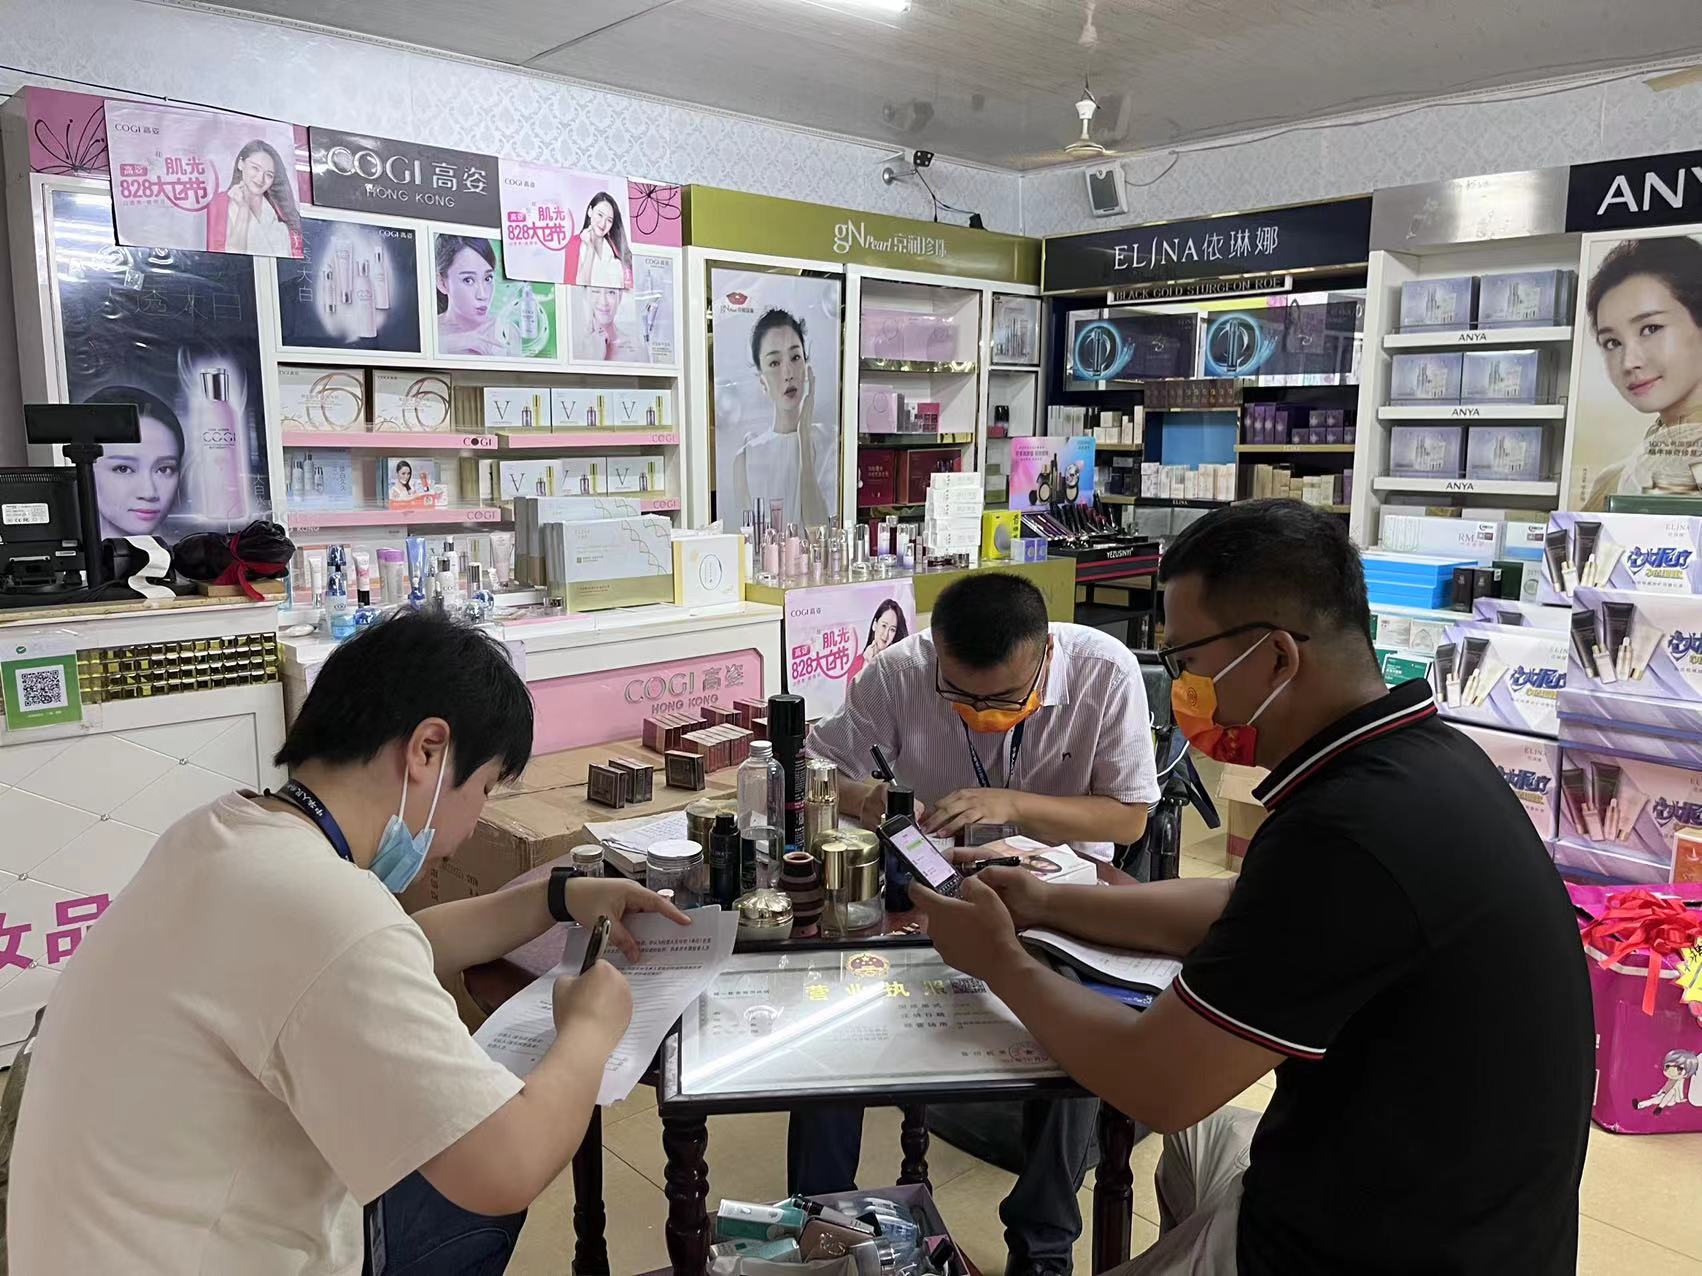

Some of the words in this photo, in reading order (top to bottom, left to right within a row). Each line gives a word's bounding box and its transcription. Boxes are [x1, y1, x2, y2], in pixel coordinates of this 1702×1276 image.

[115, 123, 141, 133] COGI
[165, 156, 206, 176] 肌光
[327, 146, 422, 185] COGI
[431, 162, 488, 195] 高姿
[504, 178, 522, 186] COGI
[365, 185, 409, 201] HONG
[415, 193, 455, 208] KONG
[538, 206, 566, 222] 肌光
[379, 230, 399, 238] COGI
[1202, 226, 1279, 261] 依琳娜
[1116, 288, 1150, 301] BLACK
[1153, 285, 1183, 298] GOLD
[1458, 332, 1487, 342] ANYA
[1452, 408, 1480, 417] ANYA
[202, 431, 236, 442] COGI
[651, 433, 675, 443] COGI
[463, 437, 492, 447] COGI
[1446, 482, 1474, 491] ANYA
[653, 500, 676, 509] COGI
[467, 511, 495, 520] COGI
[791, 609, 809, 617] COGI
[822, 627, 850, 650] 肌光
[624, 671, 695, 704] COGI
[702, 664, 745, 692] 高姿
[651, 700, 684, 715] HONG
[688, 694, 719, 709] KONG
